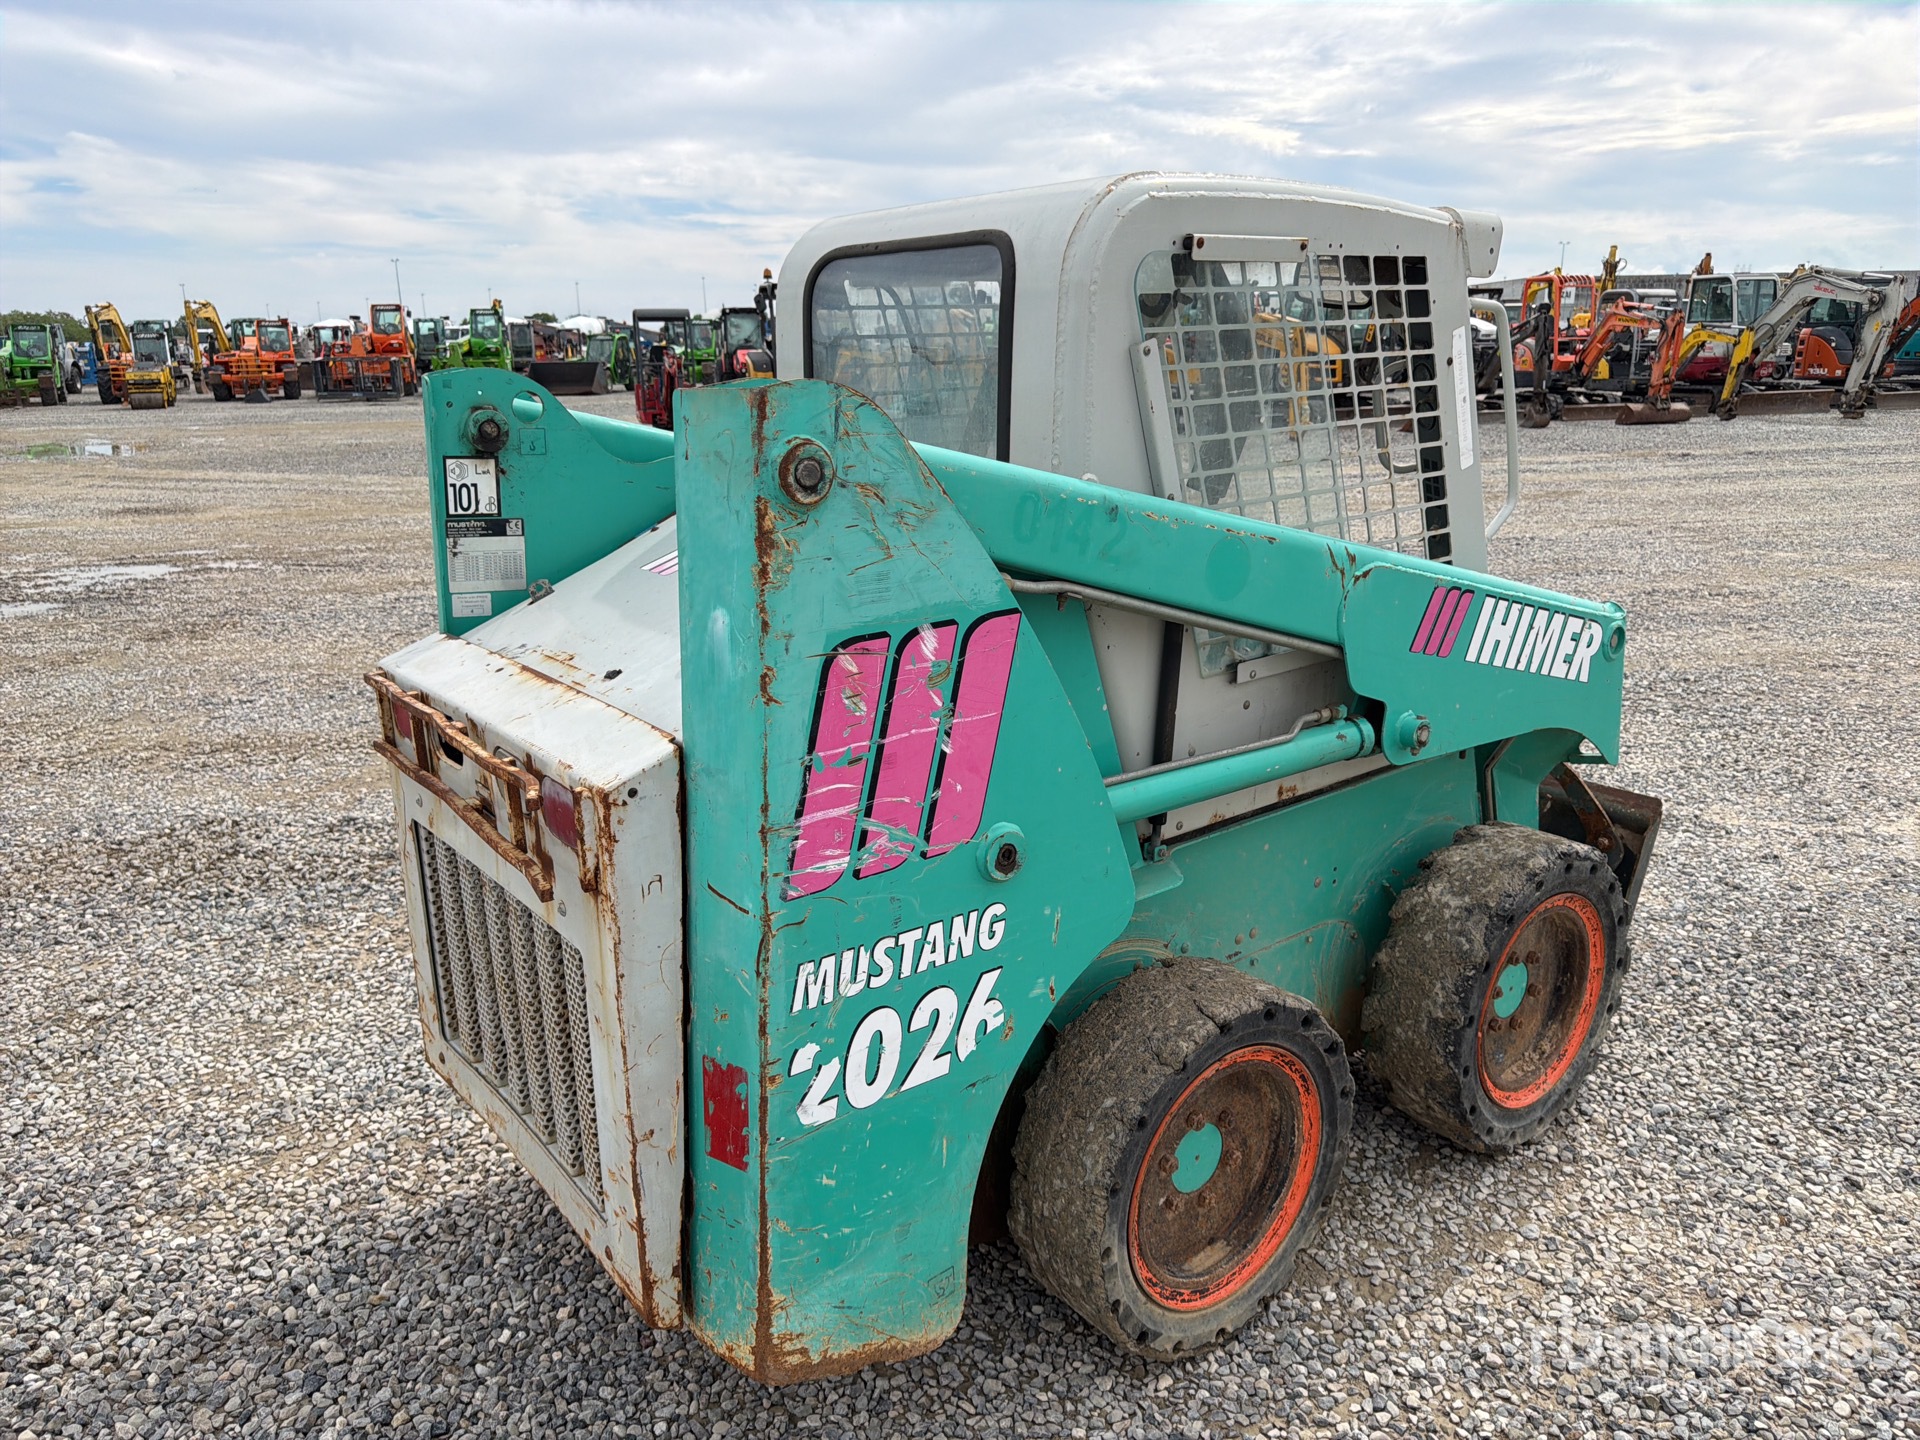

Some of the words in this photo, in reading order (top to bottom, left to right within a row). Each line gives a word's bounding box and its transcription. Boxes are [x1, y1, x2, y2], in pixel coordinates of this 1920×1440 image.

[449, 483, 479, 512] 101
[1464, 593, 1603, 683] IHIMER
[790, 901, 1007, 1016] MUSTANG
[787, 965, 1005, 1128] 2026
